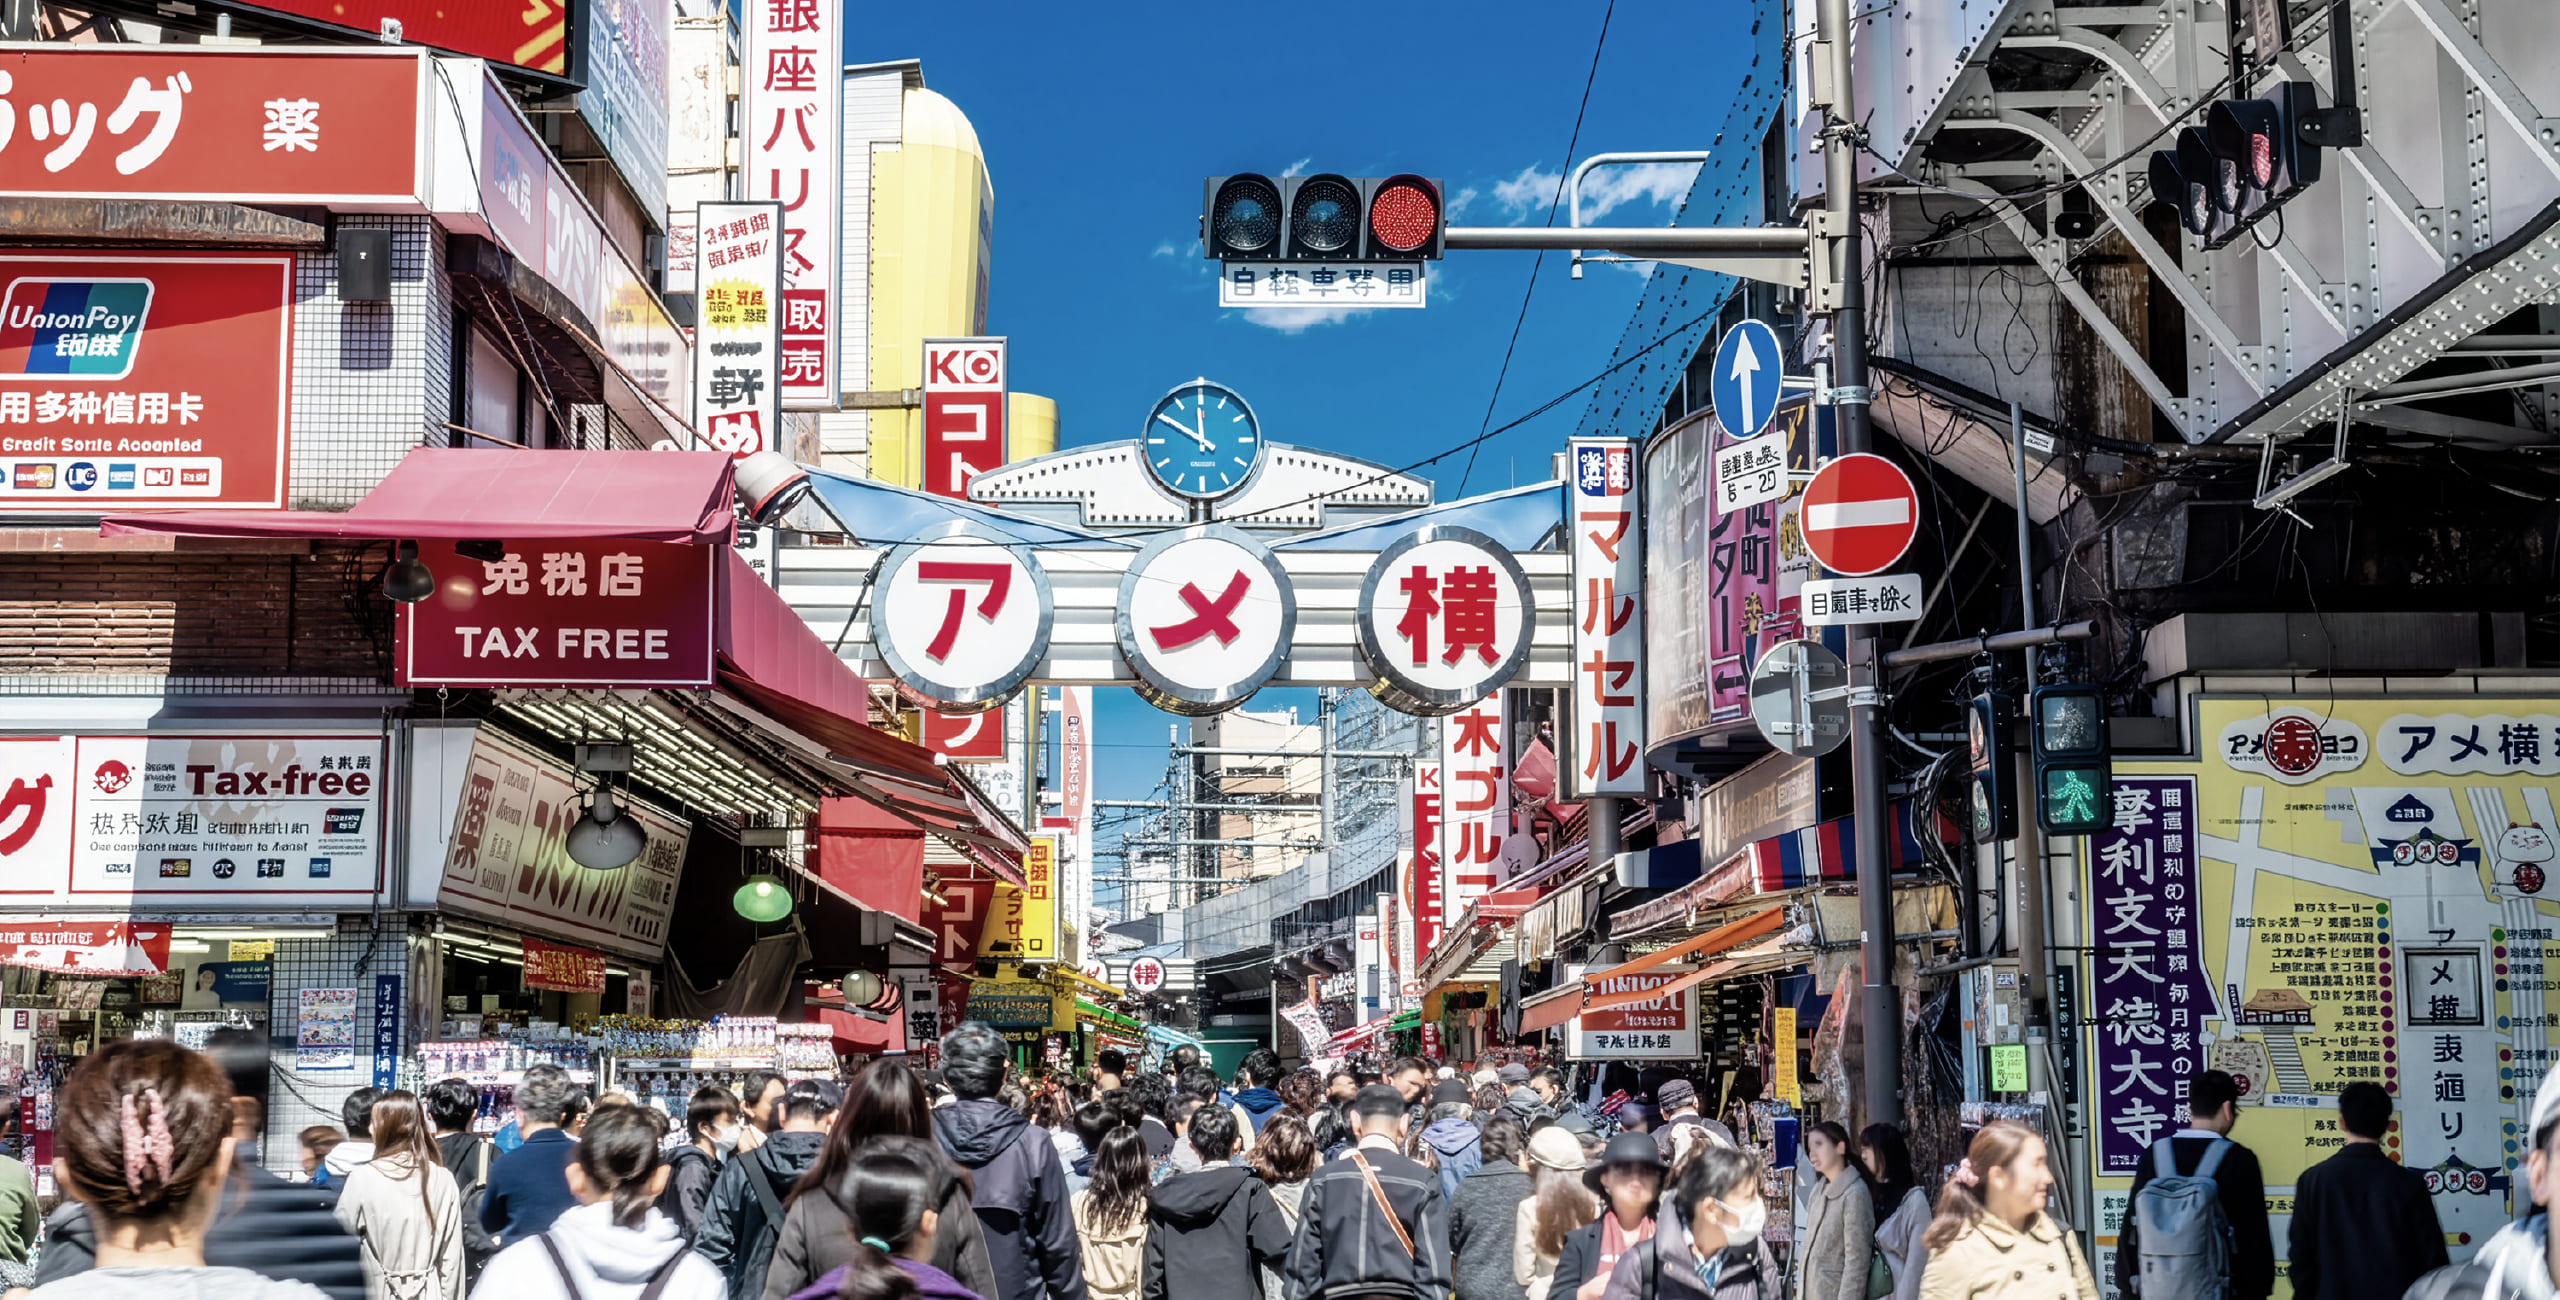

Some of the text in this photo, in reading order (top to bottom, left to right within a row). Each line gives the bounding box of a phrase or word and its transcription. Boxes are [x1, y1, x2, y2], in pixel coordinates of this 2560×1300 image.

[0, 70, 192, 175] ッグ
[263, 98, 320, 152] 薬
[784, 299, 823, 331] 取
[0, 390, 204, 426] 用多种信用卡
[482, 552, 644, 597] 免税店
[455, 627, 670, 660] TAX FREE
[1581, 511, 1638, 782] マルセル
[2399, 723, 2560, 765] アメ横
[186, 765, 371, 796] Tax-free
